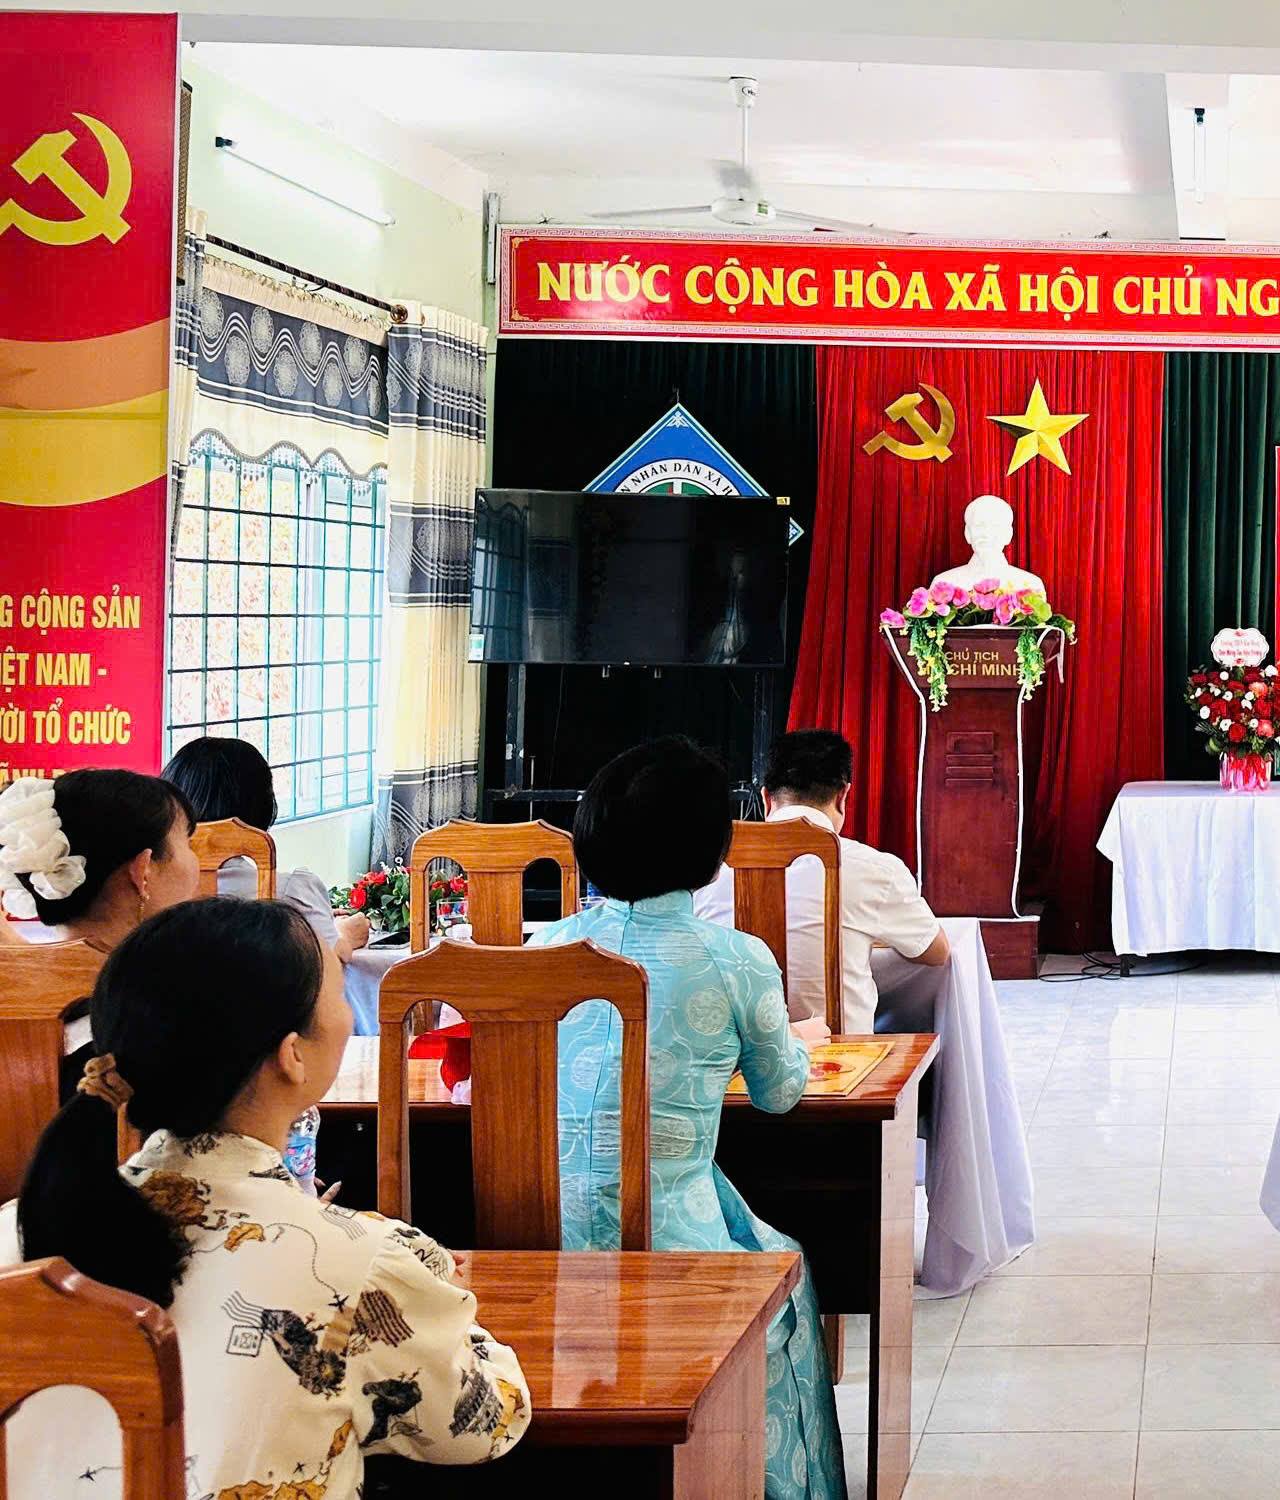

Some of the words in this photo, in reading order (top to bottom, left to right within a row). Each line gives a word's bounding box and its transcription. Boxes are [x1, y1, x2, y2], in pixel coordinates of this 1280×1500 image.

[537, 254, 670, 303] NƯỚC
[685, 258, 819, 313] CỘNG
[834, 261, 931, 310] HÒA
[944, 263, 1007, 311] XÃ
[1019, 266, 1099, 321] HỘI
[1113, 265, 1201, 315] CHỦ
[631, 463, 668, 486] NHÂN
[673, 462, 702, 476] DÂN
[21, 588, 84, 635] CỘNG
[92, 584, 140, 629] SẢN
[0, 646, 29, 692] ỆT
[35, 653, 91, 686] NAM
[944, 647, 970, 661] CHỦ
[950, 660, 977, 676] CHÍ
[32, 697, 63, 744] TỔ
[68, 704, 131, 745] CHỨC
